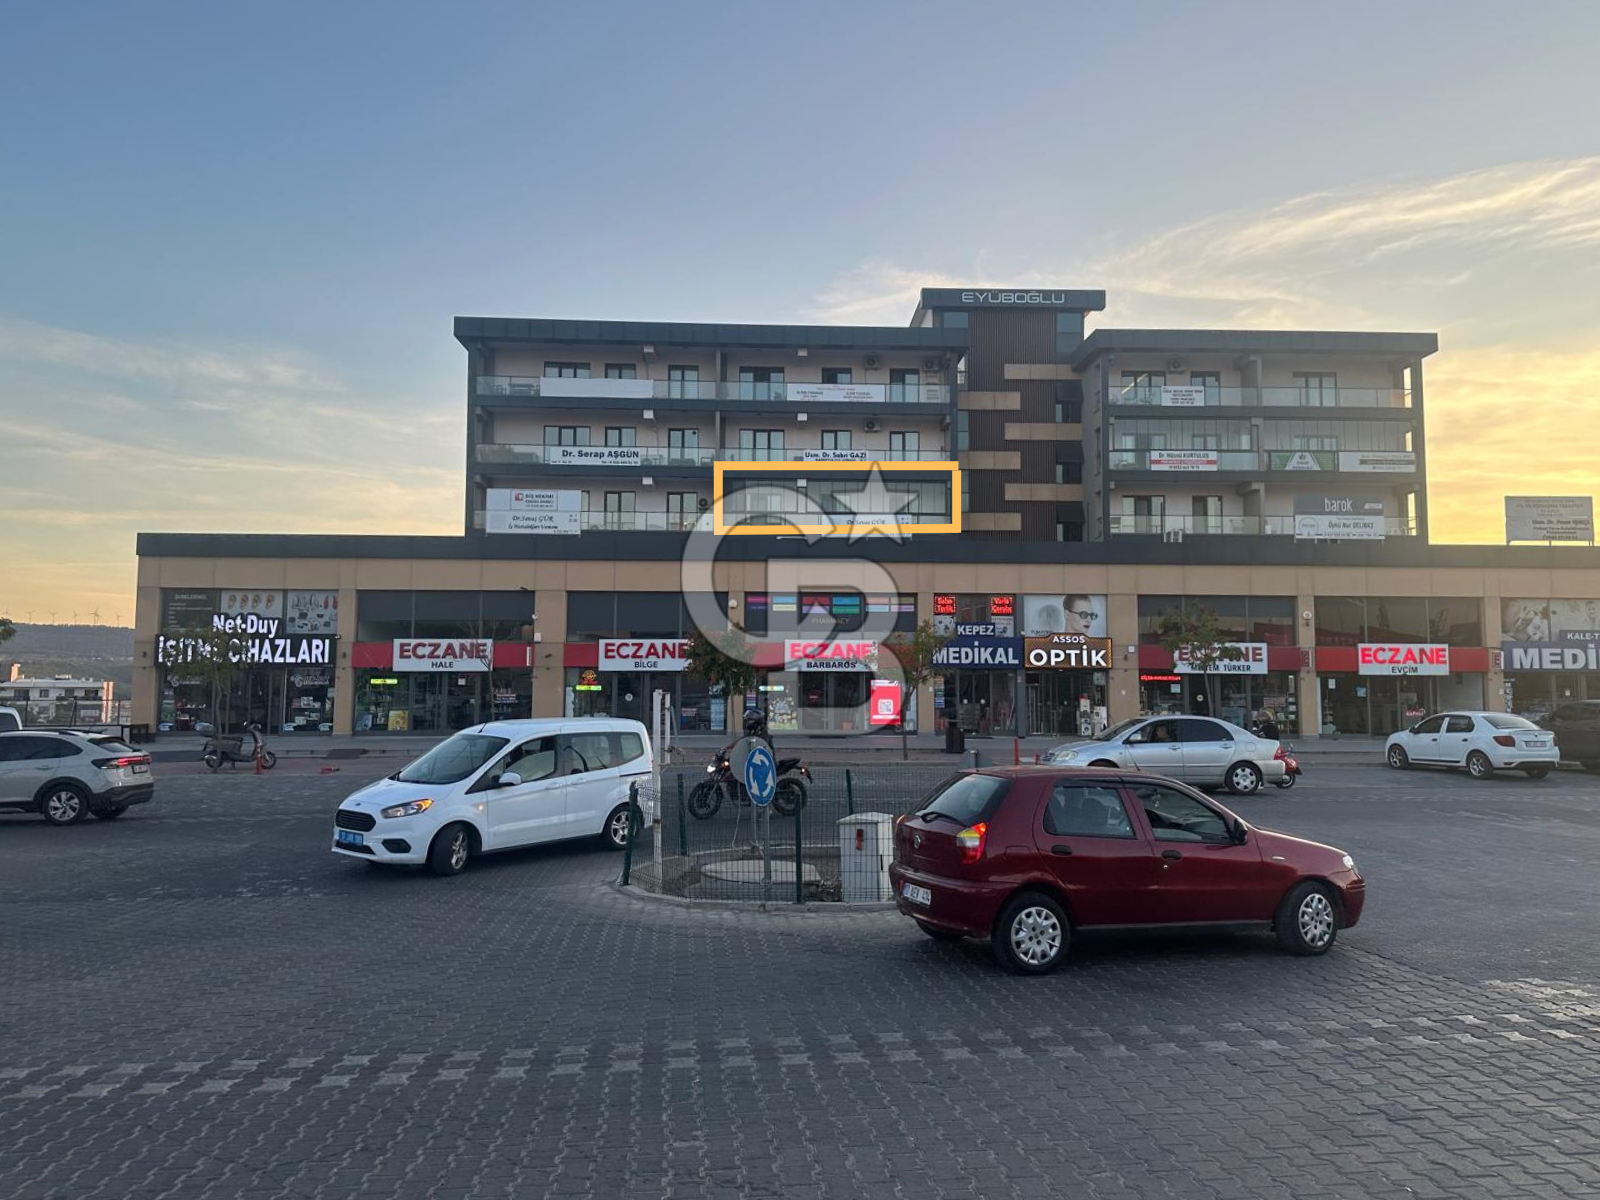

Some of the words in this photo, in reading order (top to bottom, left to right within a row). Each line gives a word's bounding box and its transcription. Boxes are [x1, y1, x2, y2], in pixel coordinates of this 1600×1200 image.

[962, 289, 1065, 304] EYÜBOĞLU
[562, 449, 575, 458] Dr.
[577, 449, 604, 459] Serap
[1324, 496, 1353, 512] barok
[212, 613, 279, 639] Net-Duy
[957, 624, 995, 636] KEPEZ
[1052, 635, 1086, 643] ASSOS
[399, 642, 487, 660] ECZANE
[932, 640, 1020, 664] MEDİKAL
[1029, 644, 1107, 667] OPTİK
[1360, 646, 1448, 665] ECZANE
[1512, 643, 1600, 670] MEDİ
[431, 661, 454, 669] HALE
[634, 659, 659, 669] BİLGE
[806, 661, 857, 669] BARBAROS
[1223, 662, 1251, 672] TÜRKER
